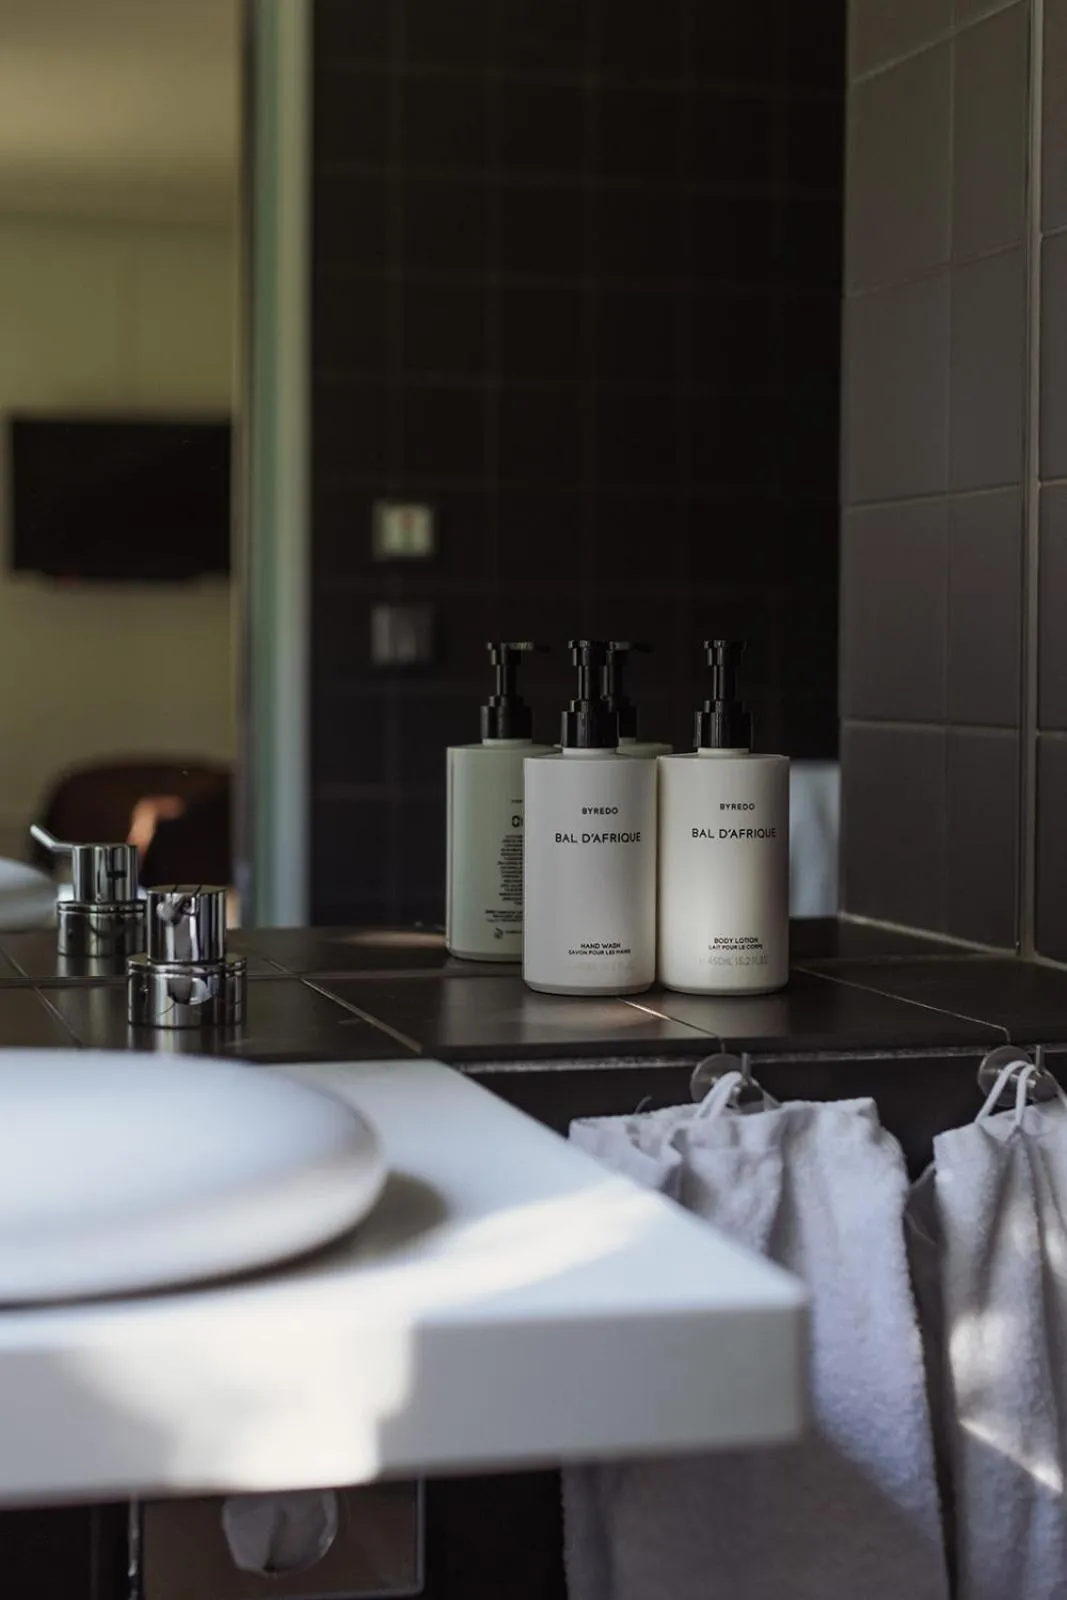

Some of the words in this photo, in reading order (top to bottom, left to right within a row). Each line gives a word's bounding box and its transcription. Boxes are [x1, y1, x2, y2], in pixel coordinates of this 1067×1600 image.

[581, 807, 618, 815] BYREDO
[719, 802, 755, 811] BYREDO
[555, 833, 578, 843] BAL
[582, 831, 641, 843] D'AFRIQUE
[691, 828, 715, 839] BAL
[719, 827, 777, 839] D'AFRIQUE
